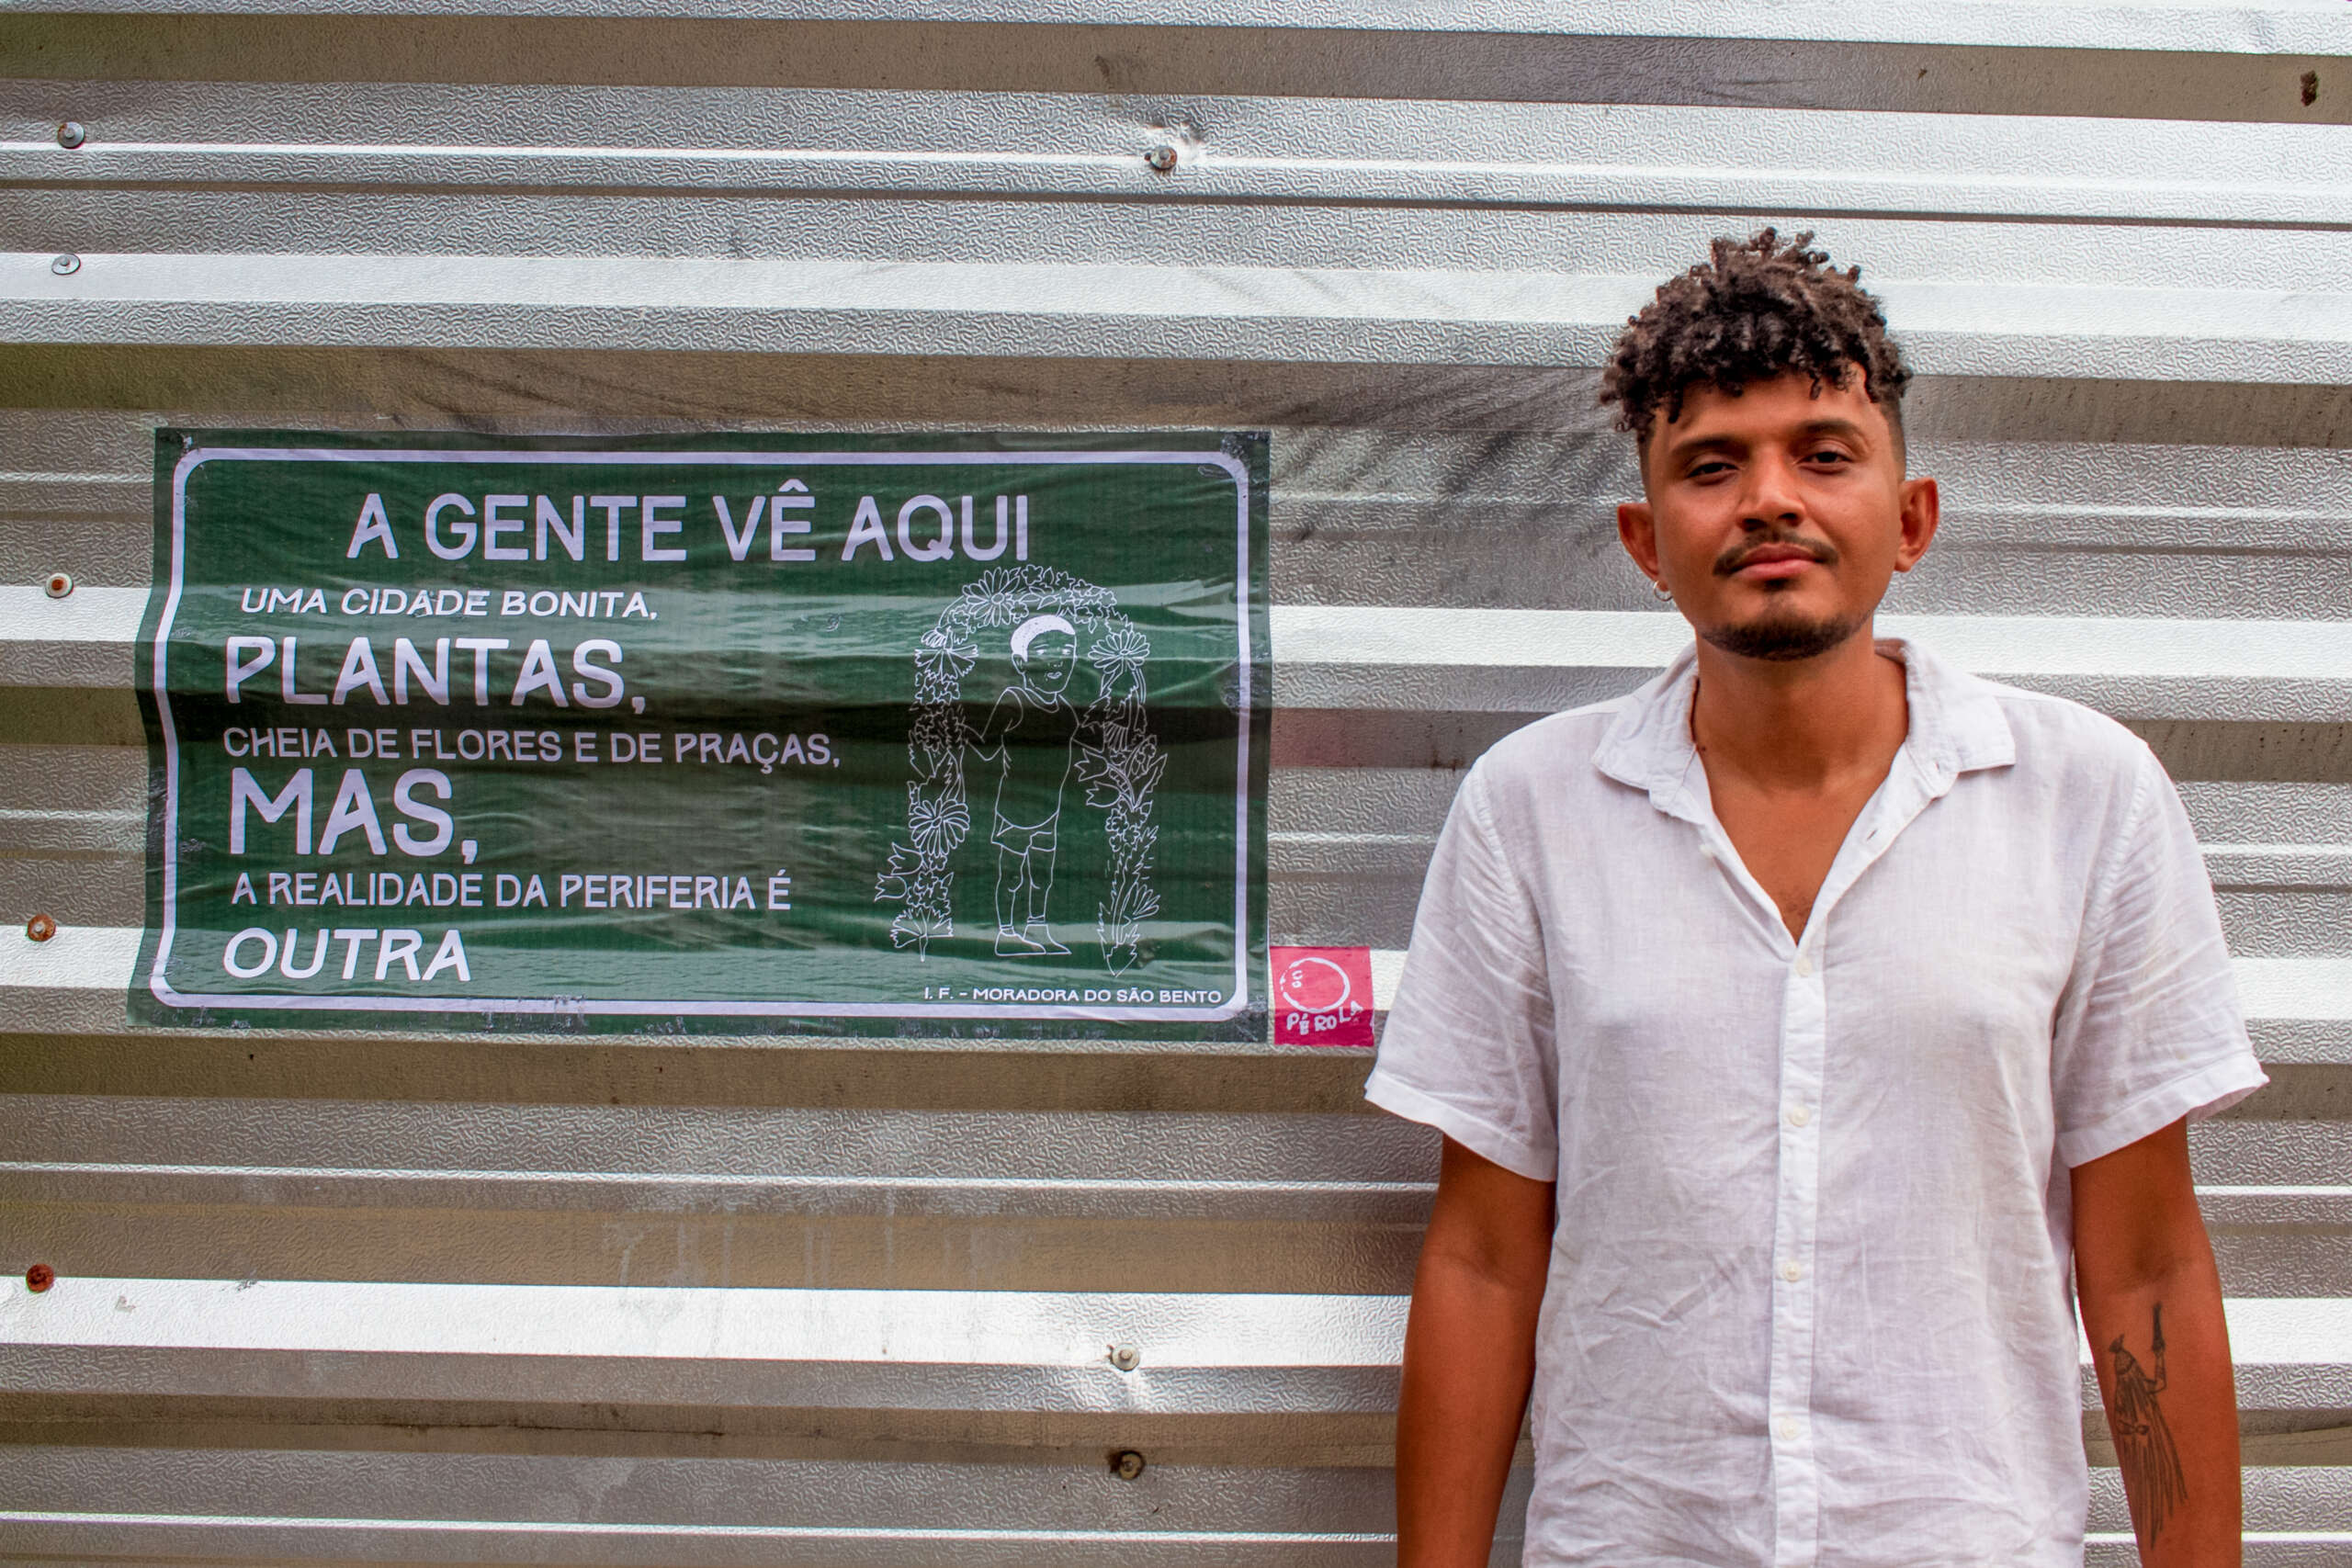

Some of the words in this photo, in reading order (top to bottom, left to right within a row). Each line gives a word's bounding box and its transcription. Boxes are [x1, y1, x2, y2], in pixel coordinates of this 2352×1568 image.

[345, 492, 398, 559] A
[424, 492, 687, 562] GENTE
[713, 479, 816, 561] VÊ
[841, 494, 1028, 561] AQUI
[241, 587, 327, 614] UMA
[340, 588, 491, 618] CIDADE
[500, 591, 658, 620] BONITA,
[226, 637, 646, 715] PLANTAS,
[223, 727, 338, 758] CHEIA
[346, 728, 400, 759] DE
[411, 728, 562, 762] FLORES
[573, 731, 598, 763] E
[609, 732, 662, 763] DE
[674, 732, 840, 775] PRAÇAS,
[229, 767, 478, 865] MAS,
[231, 872, 257, 905] A
[267, 872, 482, 908] REALIDADE
[495, 874, 548, 908] DA
[560, 874, 756, 910] PERIFERIA
[767, 869, 791, 910] É
[221, 928, 471, 982] OUTRA
[923, 987, 933, 1001] I.
[938, 987, 955, 1001] F.
[972, 987, 1080, 1002] MORADORA
[1083, 989, 1112, 1002] DO
[1116, 987, 1155, 1003] SÃO
[1159, 989, 1222, 1004] BENTO
[1286, 1000, 1363, 1035] PÉROLA
